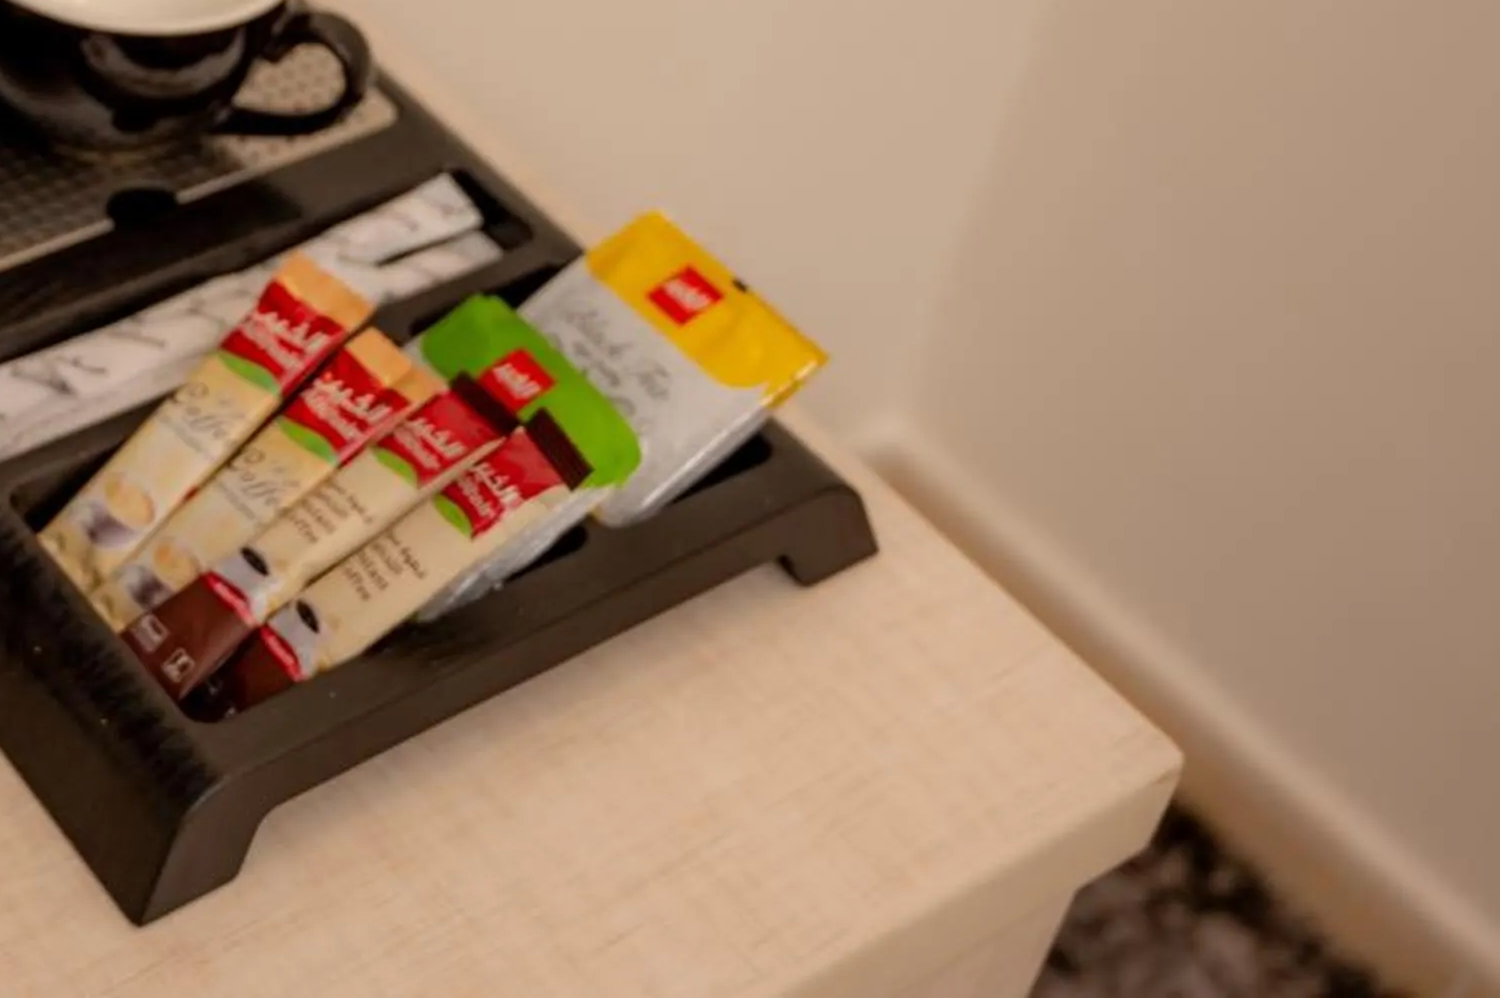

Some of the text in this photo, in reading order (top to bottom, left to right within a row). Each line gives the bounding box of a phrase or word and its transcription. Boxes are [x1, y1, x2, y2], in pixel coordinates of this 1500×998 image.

[252, 309, 330, 356] الخير
[316, 373, 392, 422] الخير
[405, 417, 466, 459] الخير
[471, 462, 522, 502] الخير
